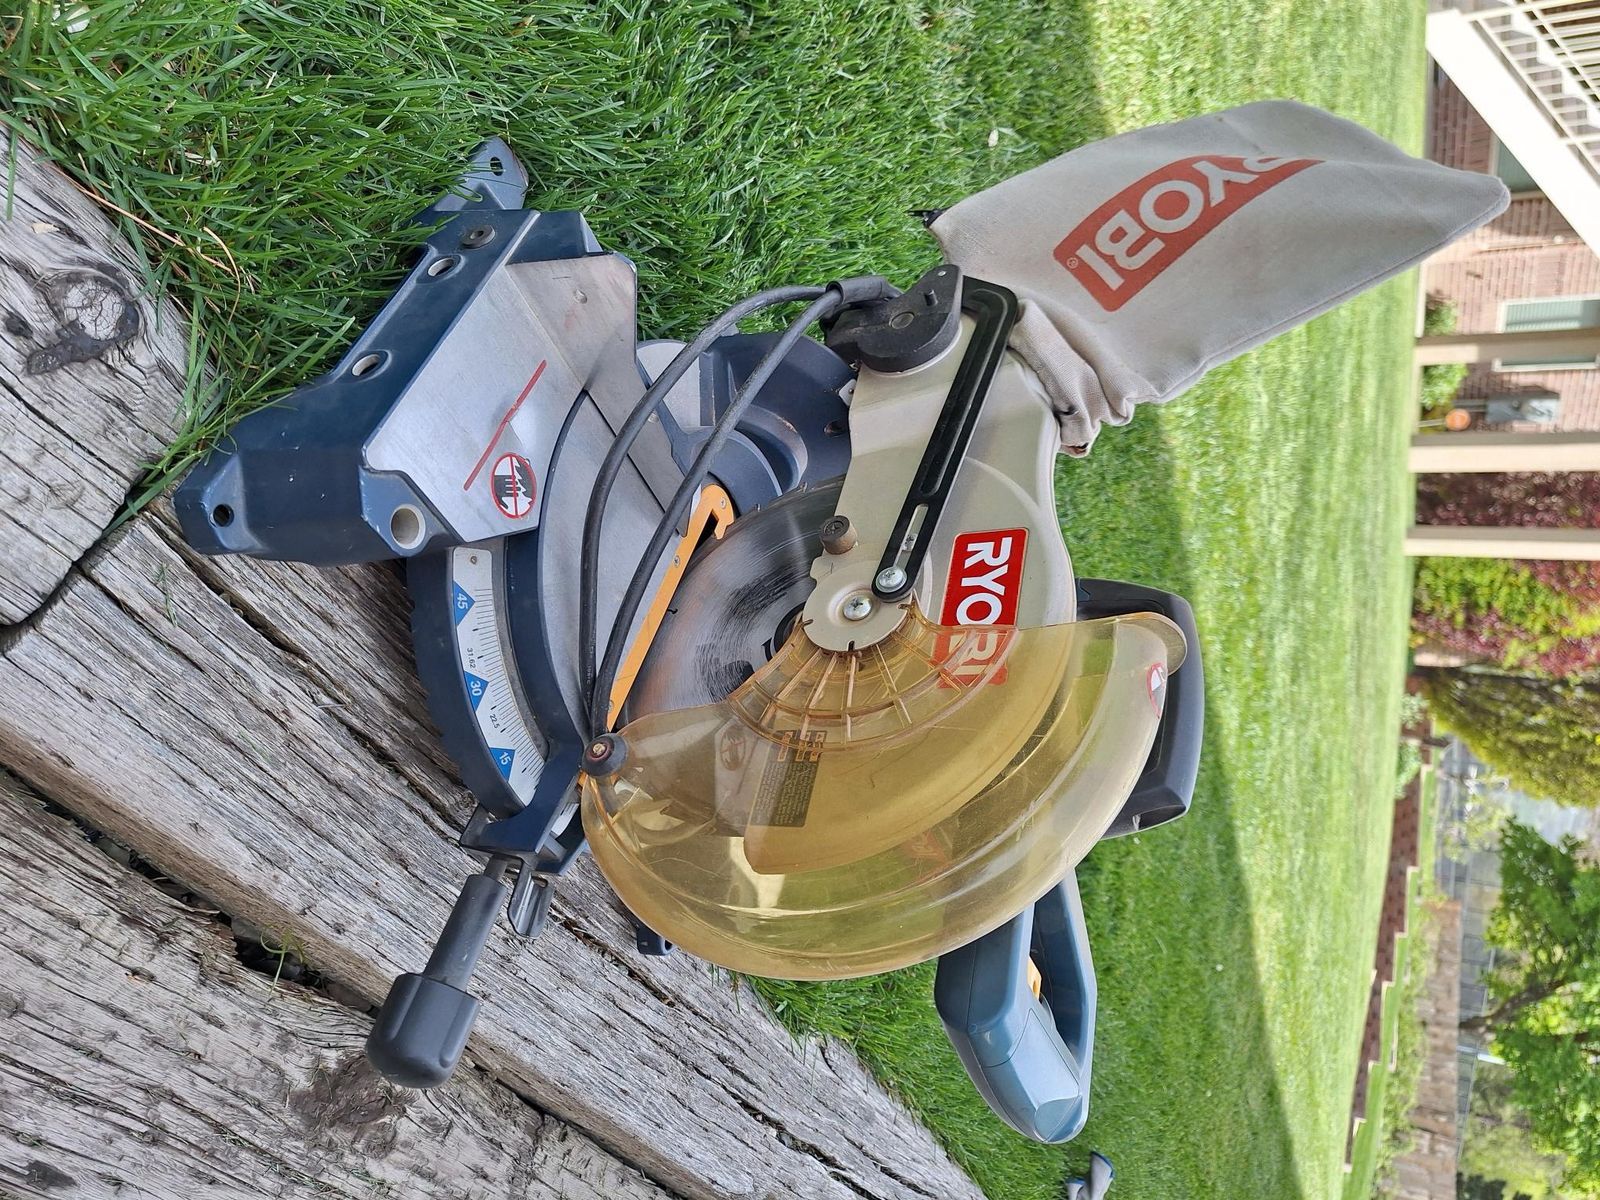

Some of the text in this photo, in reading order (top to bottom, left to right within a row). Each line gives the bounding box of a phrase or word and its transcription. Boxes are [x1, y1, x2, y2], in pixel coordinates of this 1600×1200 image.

[457, 592, 468, 609] 45
[948, 536, 1013, 677] RYOBI
[466, 647, 476, 669] 31.62
[470, 680, 482, 697] 30
[489, 713, 500, 729] 22.5
[499, 751, 511, 765] 15
